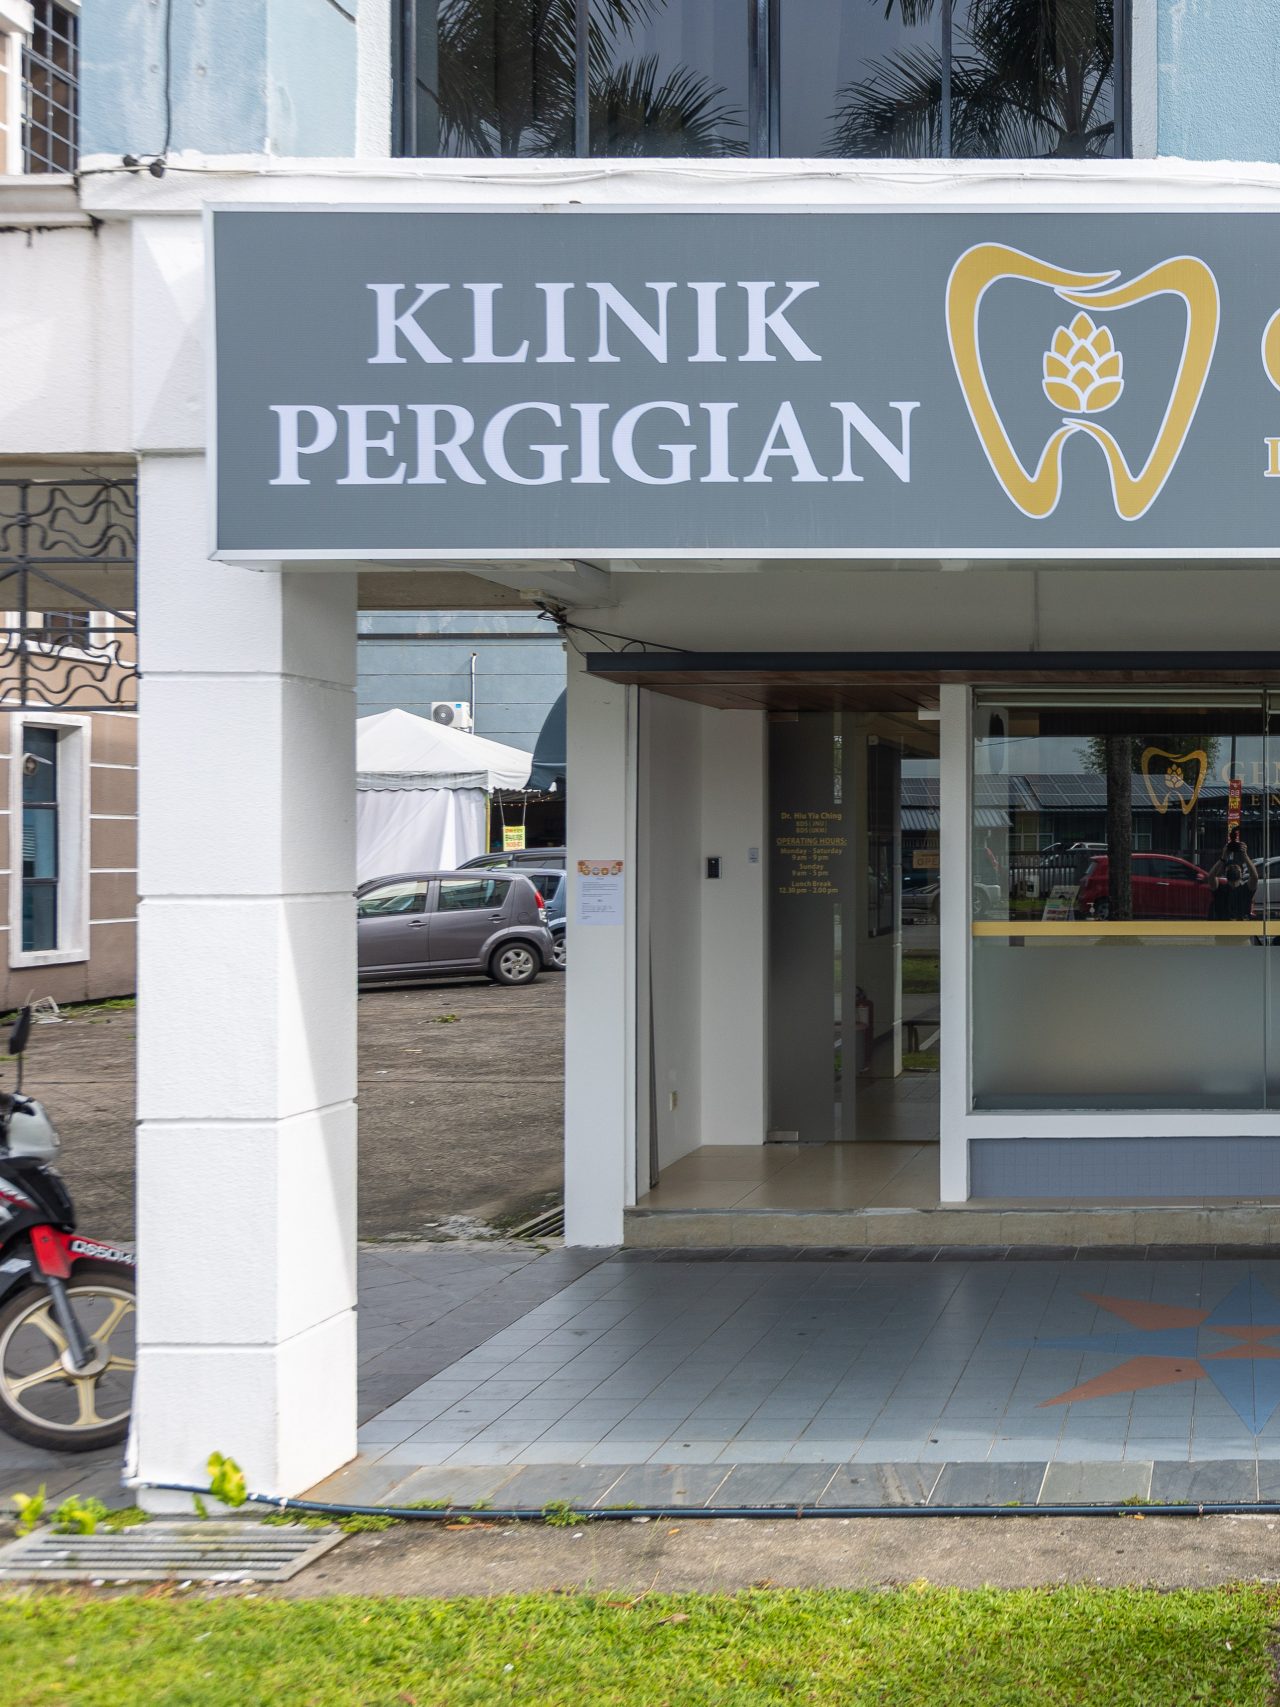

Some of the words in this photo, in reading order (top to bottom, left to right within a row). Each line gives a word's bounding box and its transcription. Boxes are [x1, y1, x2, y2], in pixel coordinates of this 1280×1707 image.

[366, 281, 821, 364] KLINIK
[269, 401, 921, 486] PERGIGIAN
[776, 837, 819, 845] OPERATING
[812, 847, 842, 855] Saturday
[799, 863, 824, 871] Sunday
